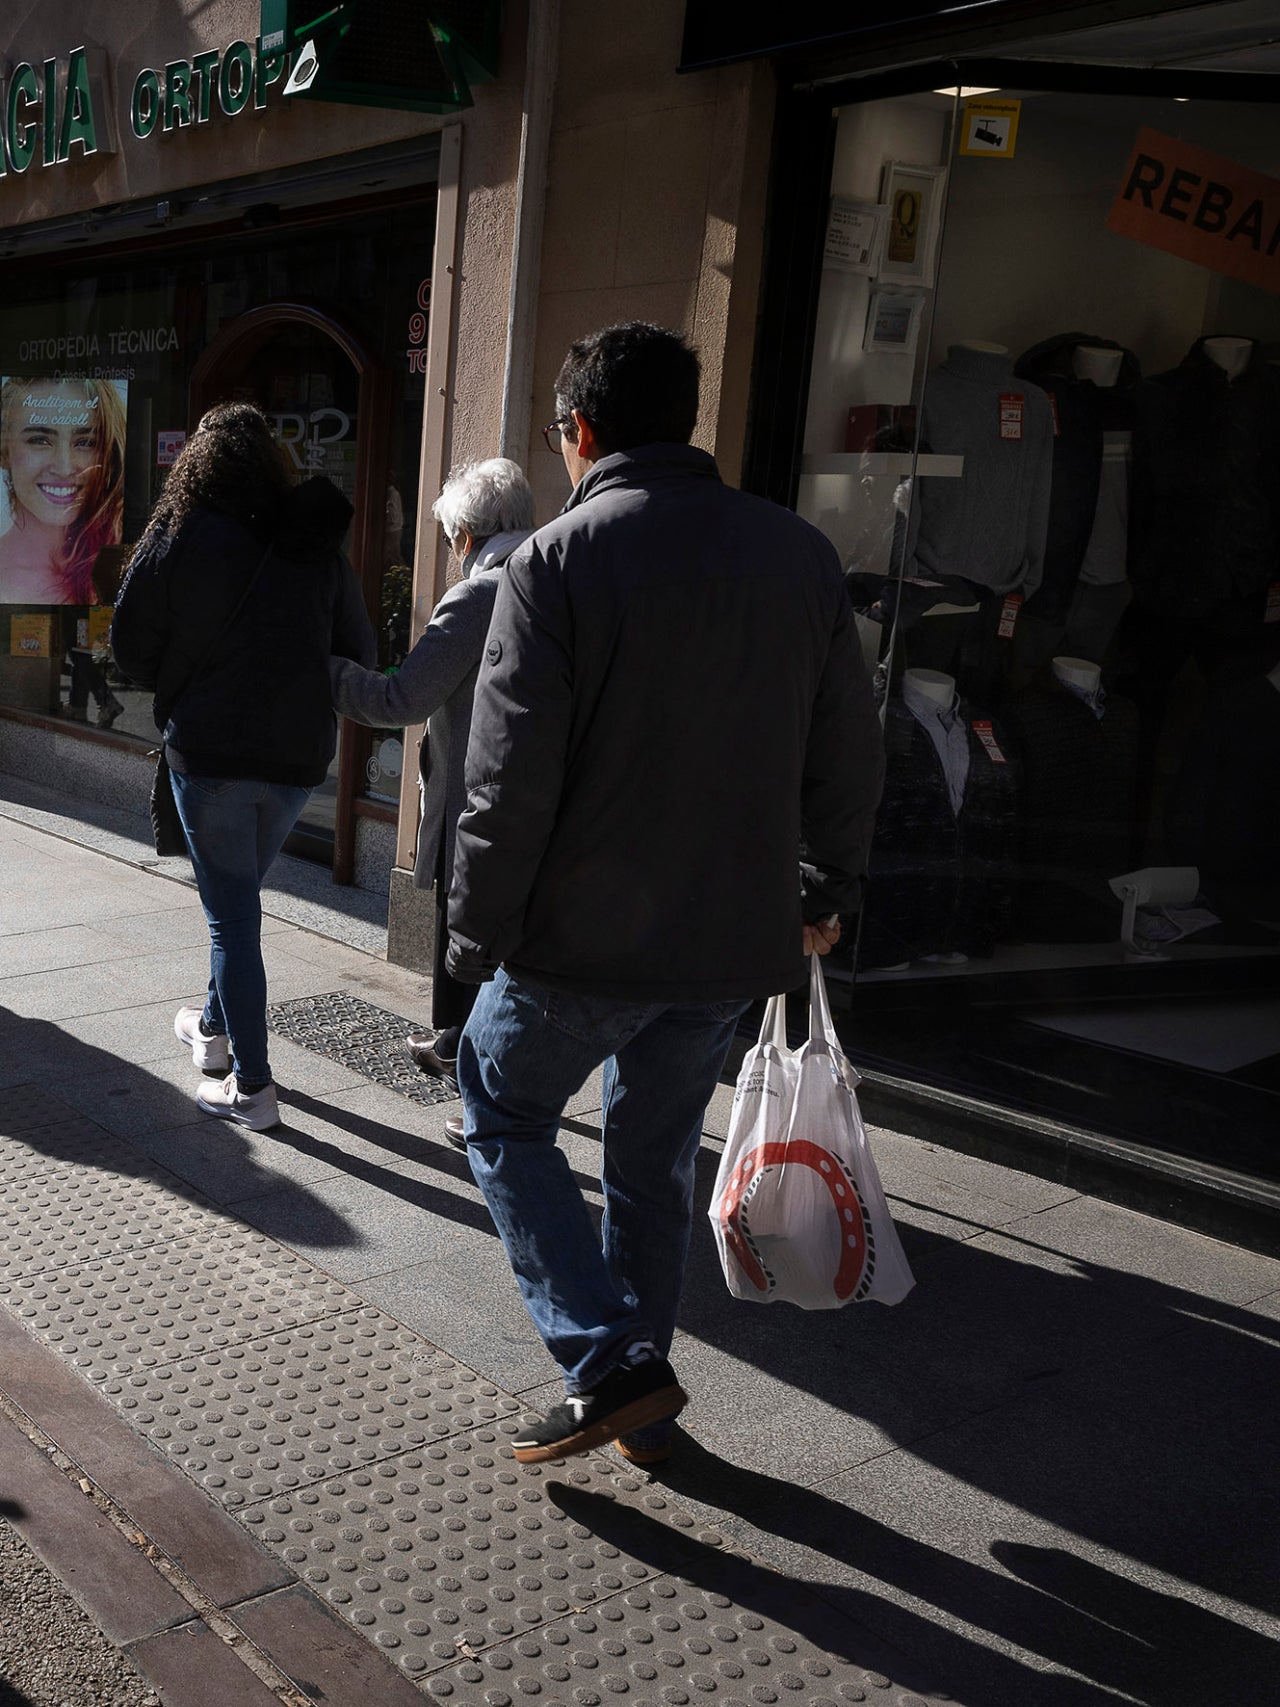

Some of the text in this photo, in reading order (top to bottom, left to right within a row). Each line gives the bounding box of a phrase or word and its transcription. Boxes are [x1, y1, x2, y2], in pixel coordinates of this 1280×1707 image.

[130, 37, 291, 140] ORTOP
[19, 325, 180, 363] ORTOPÈDIA TÈCNICA
[23, 393, 99, 414] Analitzem el
[29, 411, 89, 427] teu cabell
